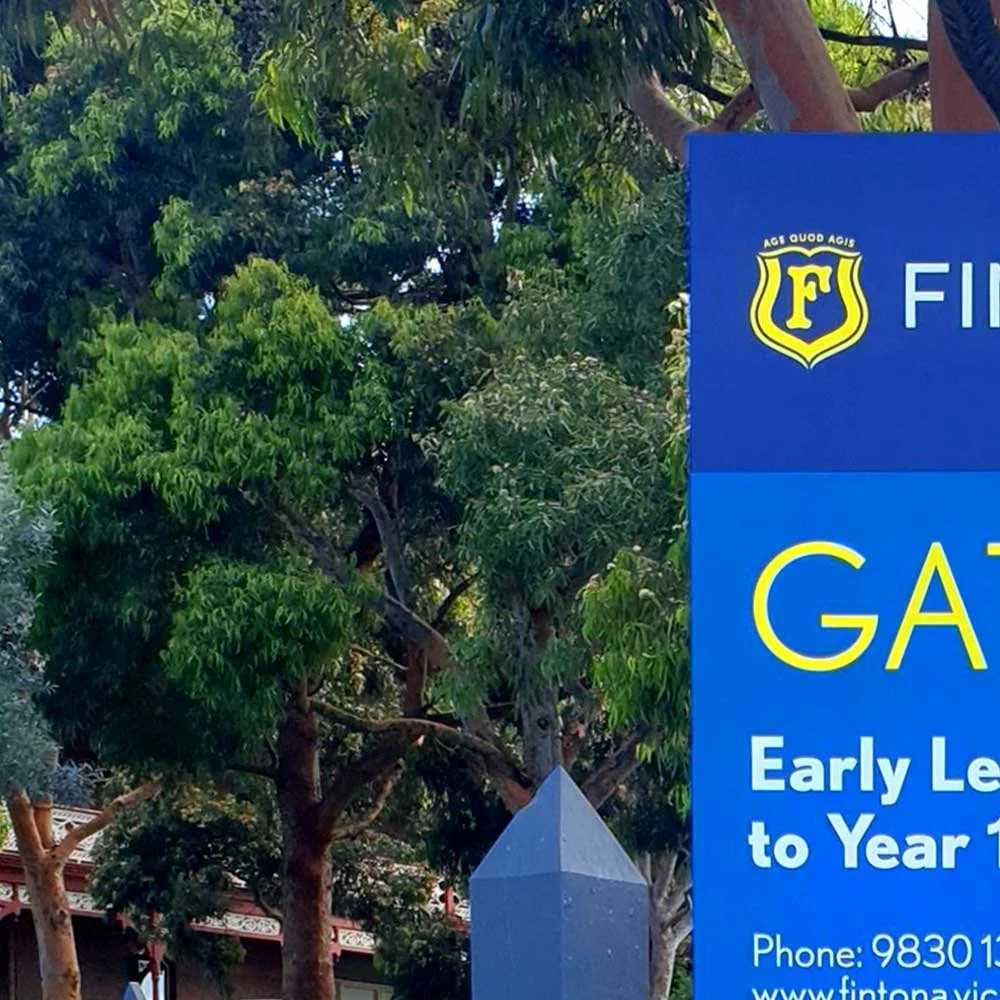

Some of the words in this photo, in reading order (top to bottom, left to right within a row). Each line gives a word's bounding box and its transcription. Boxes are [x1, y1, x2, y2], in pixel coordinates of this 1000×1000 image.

[763, 235, 786, 248] AGE
[789, 232, 824, 243] QUOD
[827, 234, 856, 248] AGIS
[786, 264, 833, 330] F
[750, 735, 911, 805] Early
[748, 821, 809, 869] to
[827, 813, 970, 869] Year
[753, 933, 863, 968] Phone:
[872, 934, 972, 968] 9830
